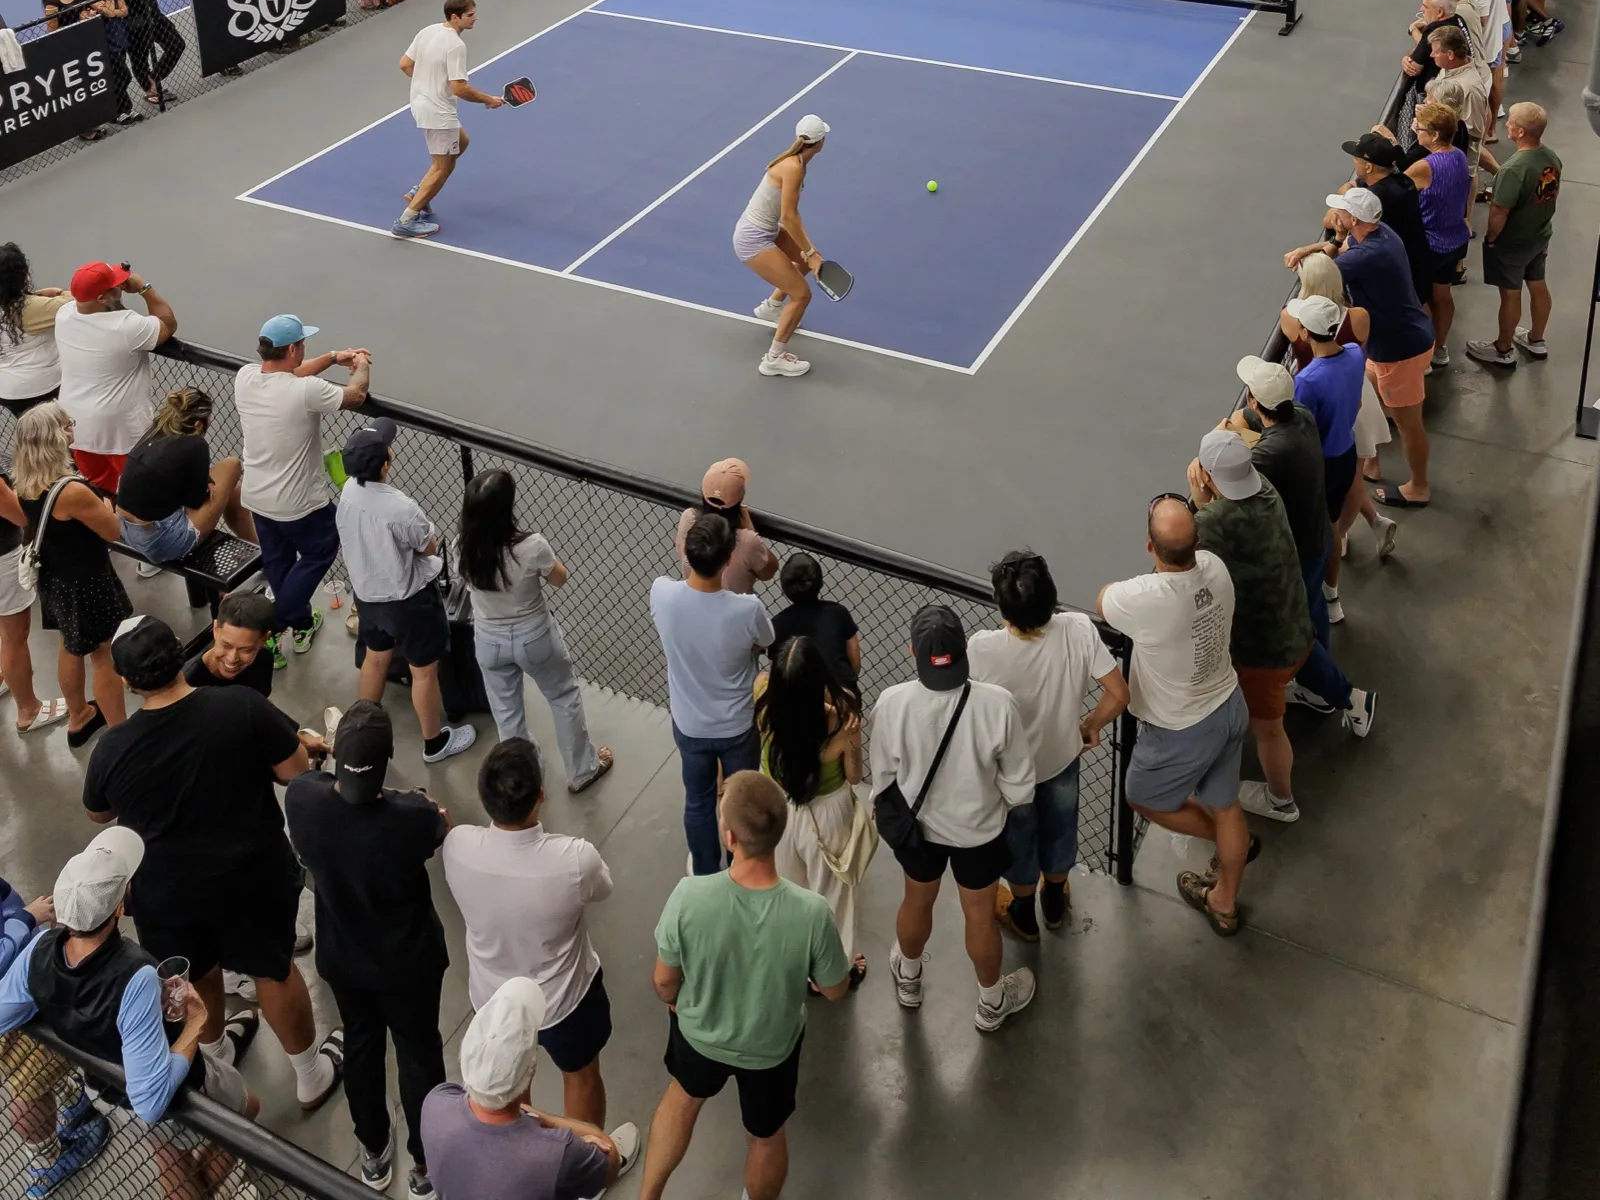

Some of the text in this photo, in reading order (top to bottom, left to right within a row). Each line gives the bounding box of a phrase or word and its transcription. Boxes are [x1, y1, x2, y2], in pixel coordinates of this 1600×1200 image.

[0, 50, 104, 111] RYES
[0, 78, 107, 137] REWING CO
